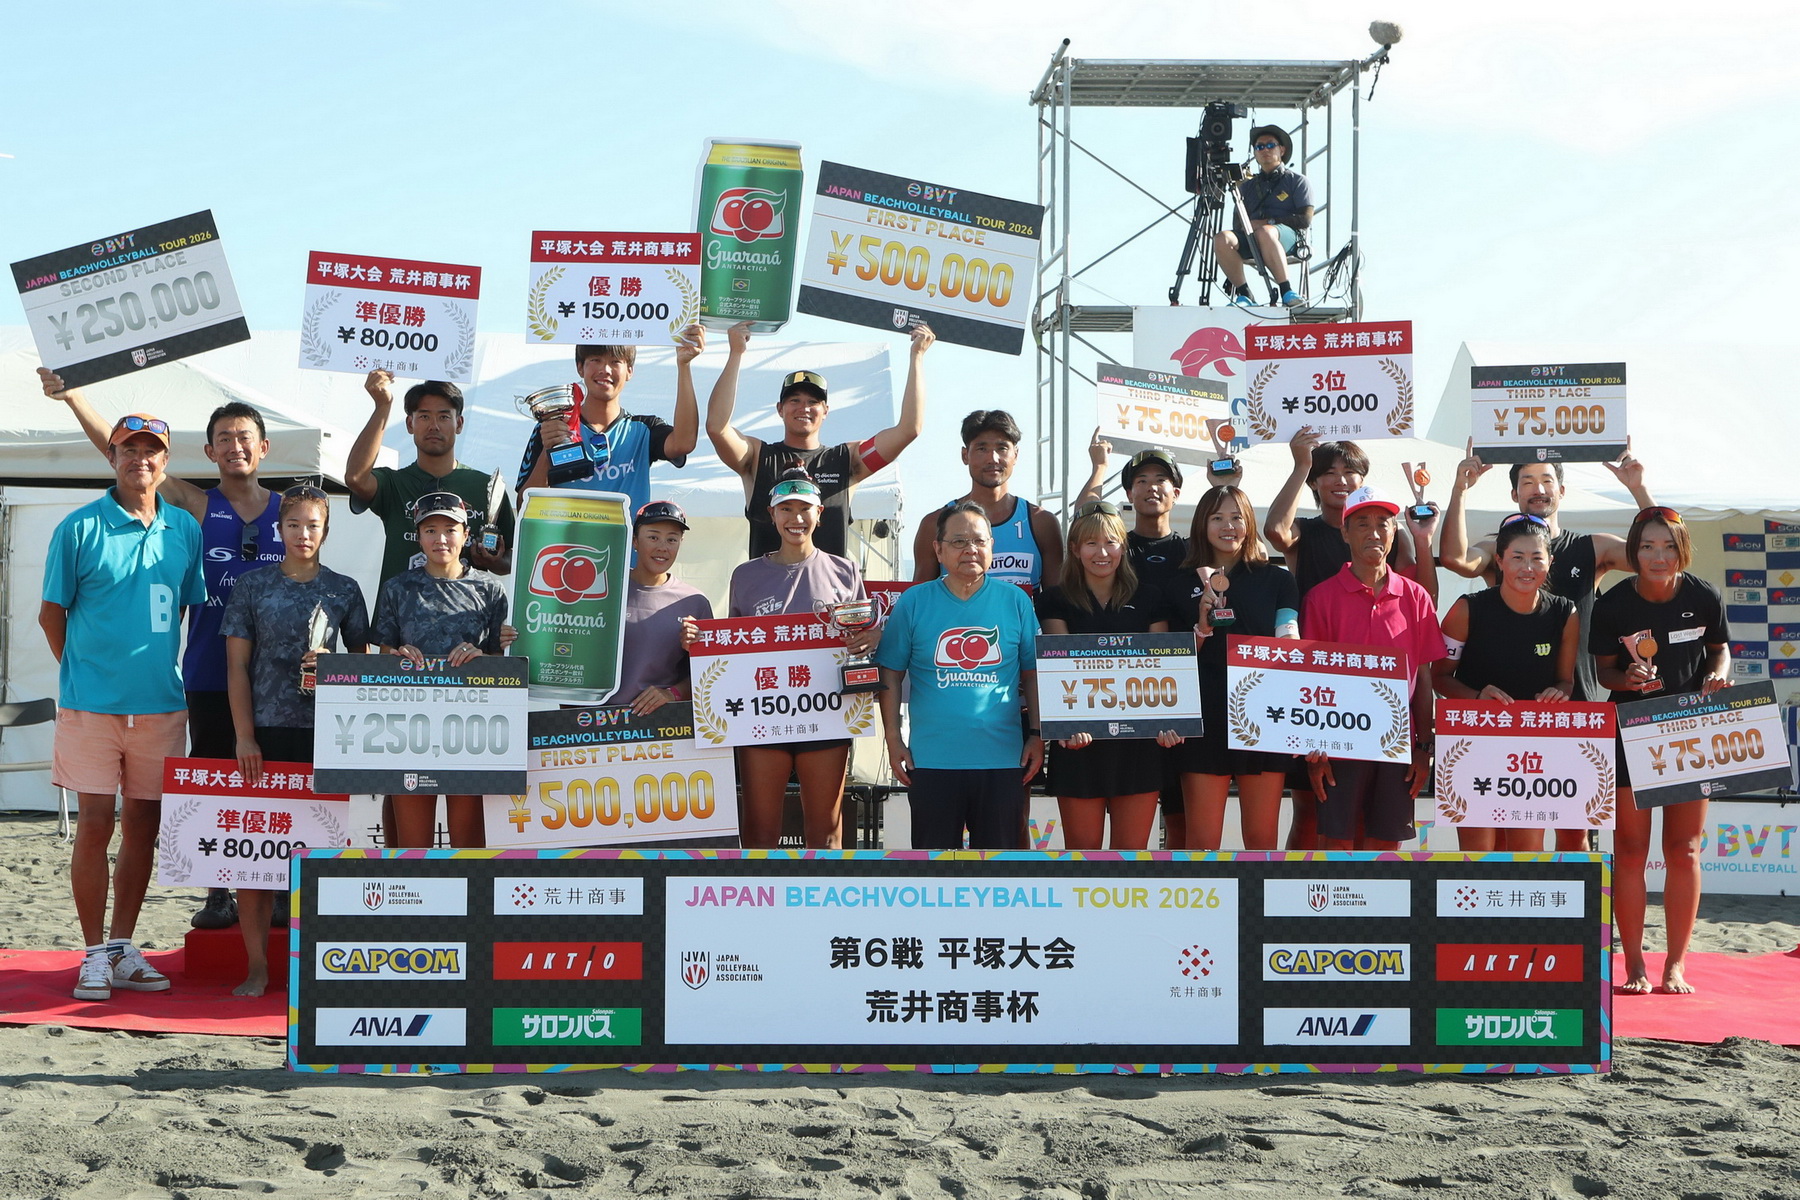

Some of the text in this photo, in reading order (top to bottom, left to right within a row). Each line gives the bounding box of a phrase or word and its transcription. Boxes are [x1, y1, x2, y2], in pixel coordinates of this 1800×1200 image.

[924, 186, 957, 205] BVT
[825, 185, 1033, 235] JAPAN BEACHVOLLEYBALL TOUR 2026
[867, 208, 987, 245] FIRST PLACE
[105, 234, 135, 253] BVT
[541, 240, 692, 257] 平塚大会 荒井商事杯
[25, 231, 212, 289] JAPAN BEACHVOLLEYBALL TOUR 2026
[707, 240, 782, 270] Guaraná
[60, 252, 187, 297] SECOND PLACE
[317, 261, 471, 290] 平塚大会 荒井商事杯
[721, 263, 768, 273] ANTARCTICA
[355, 301, 426, 327] 準優勝
[598, 328, 644, 339] 荒井商事
[1254, 330, 1404, 352] 平塚大会 荒井商事杯
[372, 358, 418, 371] 荒井商事
[1542, 366, 1564, 376] BVT
[1102, 376, 1224, 401] JAPAN BEACHVOLLEYBALL TOUR 2026
[1158, 373, 1177, 384] BVT
[1312, 370, 1347, 392] 3位
[1477, 380, 1500, 388] JAPAN
[1503, 379, 1578, 387] BEACHVOLLEYBALL
[1604, 376, 1621, 384] 2026
[1127, 388, 1199, 407] THIRD PLACE
[1507, 387, 1592, 399] THIRD PLACE
[1318, 424, 1362, 435] 荒井商事
[583, 512, 610, 521] ORIGINAL
[1014, 521, 1022, 539] 1
[988, 555, 1028, 570] UTOKU
[526, 601, 606, 634] Guaraná
[541, 626, 591, 636] ANTARCTICA
[699, 623, 852, 647] 平塚大会 荒井商事
[1109, 636, 1132, 646] BVT
[1041, 647, 1191, 658] JAPAN BEACHVOLLEYBALL TOUR 2026
[1237, 644, 1397, 671] 平塚大会 荒井商事杯
[1073, 658, 1161, 670] THIRD PLACE
[324, 674, 521, 685] JAPAN BEACHVOLLEYBALL TOUR 2026
[936, 668, 999, 689] Guaraná
[356, 688, 489, 703] SECOND PLACE
[1299, 686, 1337, 707] 3位
[596, 709, 632, 727] BVT
[1445, 709, 1606, 729] 平塚大会 荒井商事杯
[1625, 696, 1771, 726] JAPAN BEACHVOLLEYBALL TOUR 2026
[770, 723, 819, 737] 荒井商事
[1657, 711, 1744, 734] THIRD PLACE
[532, 726, 692, 747] BEACHVOLLEYBALL TOUR
[1305, 738, 1353, 752] 荒井商事
[541, 743, 674, 767] FIRST PLACE
[1506, 751, 1544, 774] 3位
[174, 768, 243, 788] 平塚大会
[216, 808, 293, 835] 準優勝
[1511, 810, 1559, 821] 荒井商事
[1717, 824, 1797, 858] BVT
[236, 871, 287, 883] 荒井商事
[544, 888, 627, 905] 荒井商事
[685, 886, 1220, 909] JAPAN BEACHVOLLEYBALL TOUR 2026
[1486, 890, 1567, 908] 荒井商事
[322, 948, 460, 974] CAPCOM
[521, 945, 615, 977] AKTIO
[716, 954, 739, 962] JAPAN
[830, 936, 1076, 970] 第6戦 平塚大会
[1269, 949, 1404, 975] CAPCOM
[716, 964, 759, 972] VOLLEYBALL
[1464, 948, 1556, 979] AKTIO
[716, 973, 763, 982] ASSOCIATION
[1169, 986, 1222, 999] 荒井商事
[866, 990, 1040, 1024] 荒井商事杯
[349, 1017, 402, 1037] ANA
[522, 1015, 613, 1038] サロンパス
[1296, 1017, 1348, 1036] ANA
[1465, 1015, 1554, 1039] サロンパス
